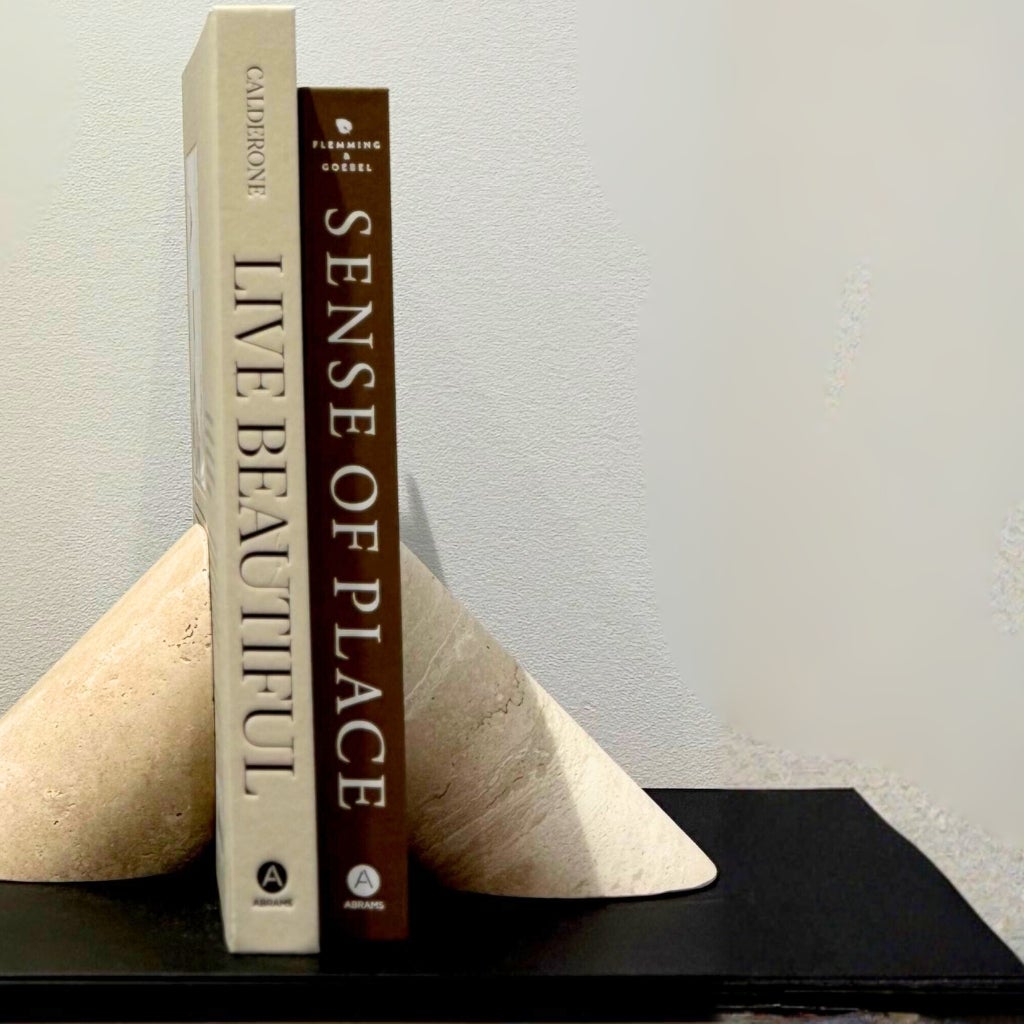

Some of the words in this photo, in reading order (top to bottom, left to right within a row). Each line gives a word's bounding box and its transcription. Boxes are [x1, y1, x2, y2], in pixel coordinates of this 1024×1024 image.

[245, 65, 266, 199] CALDERONE
[311, 140, 382, 150] FLEMMING
[321, 163, 373, 173] GOEBEL
[233, 253, 286, 398] LIVE
[324, 207, 377, 438] SENSE
[329, 464, 380, 553] OF
[236, 417, 295, 797] BEAUTIFUL
[333, 577, 386, 810] PLACE
[343, 899, 386, 911] ABRAMS
